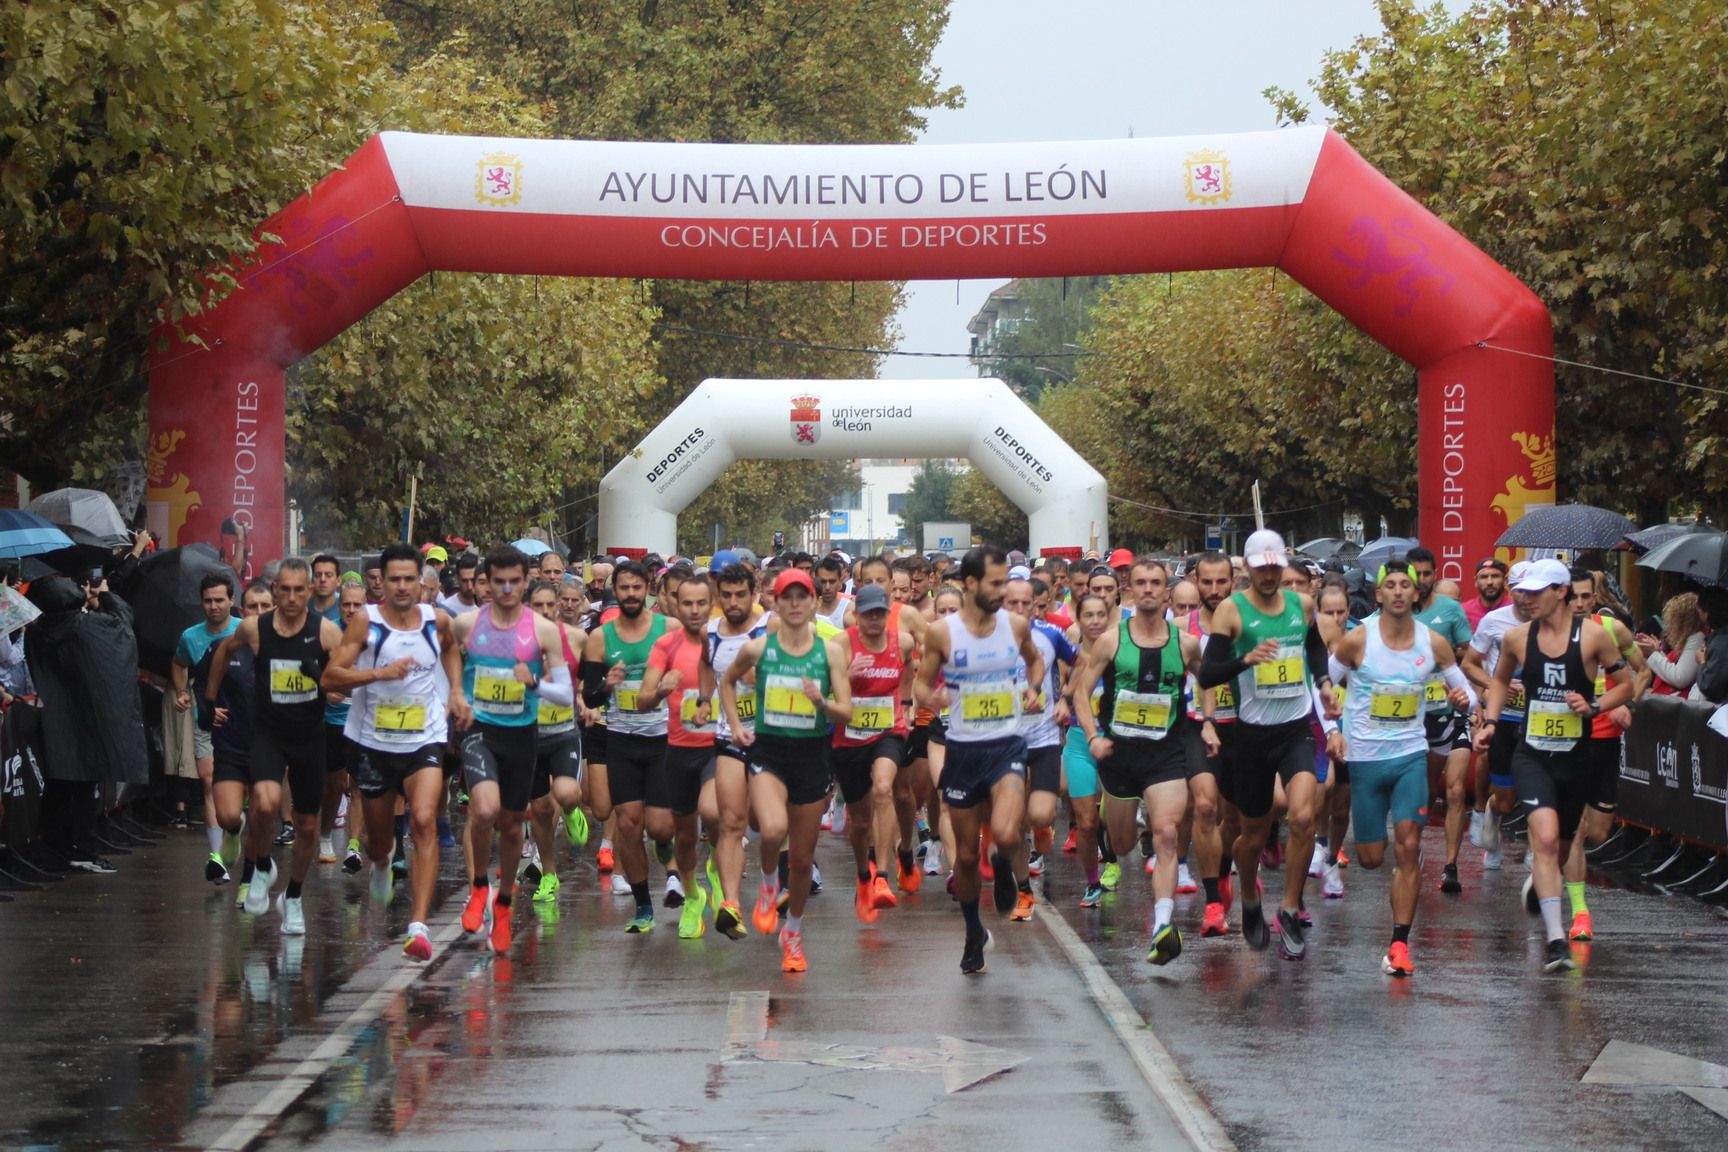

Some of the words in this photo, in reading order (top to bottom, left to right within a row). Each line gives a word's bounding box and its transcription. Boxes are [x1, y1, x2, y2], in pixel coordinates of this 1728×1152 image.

[600, 172, 924, 205] AYUNTAMIENTO
[939, 173, 988, 203] DE
[1004, 163, 1107, 202] LEÓN
[660, 219, 838, 251] CONCEJALÍA
[851, 225, 887, 248] DE
[900, 223, 1047, 248] DEPORTES
[832, 405, 912, 418] universidad
[843, 416, 872, 432] león
[232, 381, 259, 530] DEPORTES
[646, 427, 705, 483] DEPORTES
[995, 426, 1052, 482] DEPORTES
[1443, 383, 1465, 531] DEPORTES
[1442, 544, 1464, 582] DE
[1278, 664, 1287, 683] 8
[492, 683, 506, 701] 31
[979, 698, 999, 718] 35
[1136, 708, 1148, 725] 5
[1392, 700, 1402, 717] 2
[397, 711, 407, 729] 7
[861, 711, 879, 728] 37
[1545, 719, 1564, 737] 85
